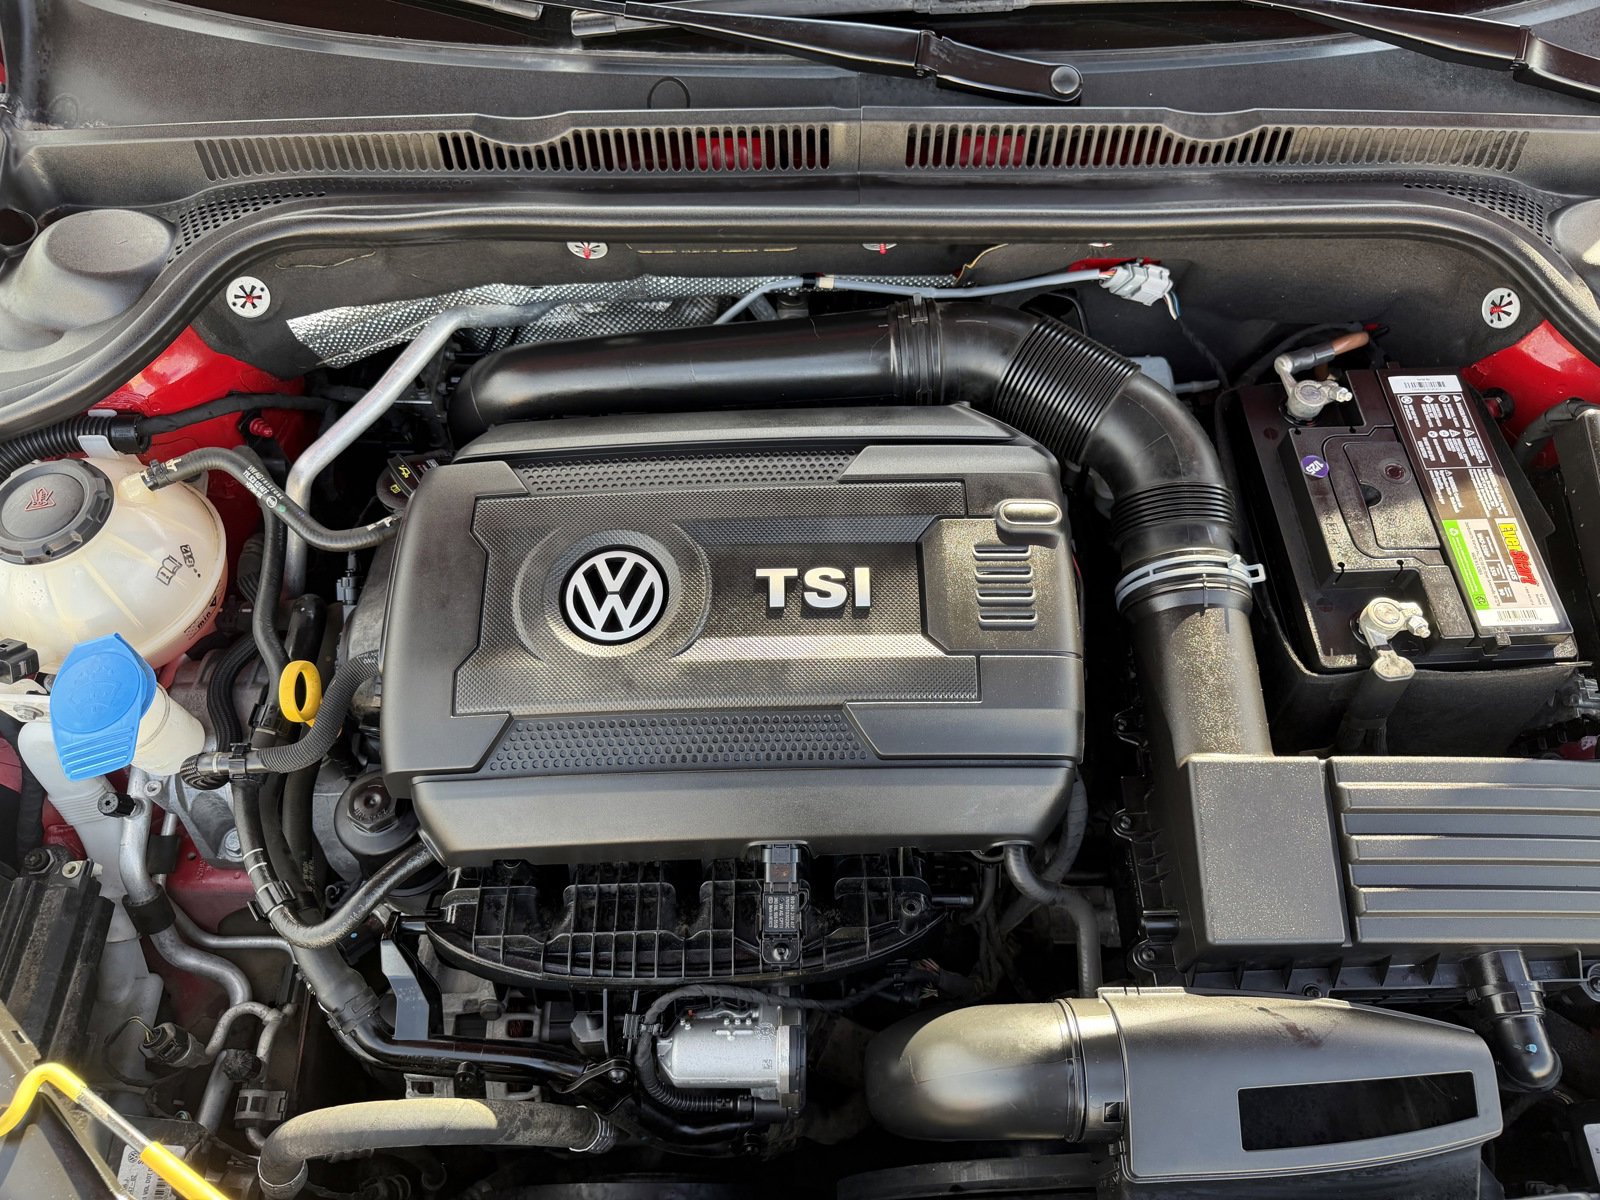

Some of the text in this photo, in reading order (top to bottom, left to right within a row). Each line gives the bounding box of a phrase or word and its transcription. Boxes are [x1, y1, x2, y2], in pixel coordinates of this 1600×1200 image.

[1498, 522, 1537, 585] EverStart
[755, 566, 873, 612] TSI
[197, 611, 211, 629] min
